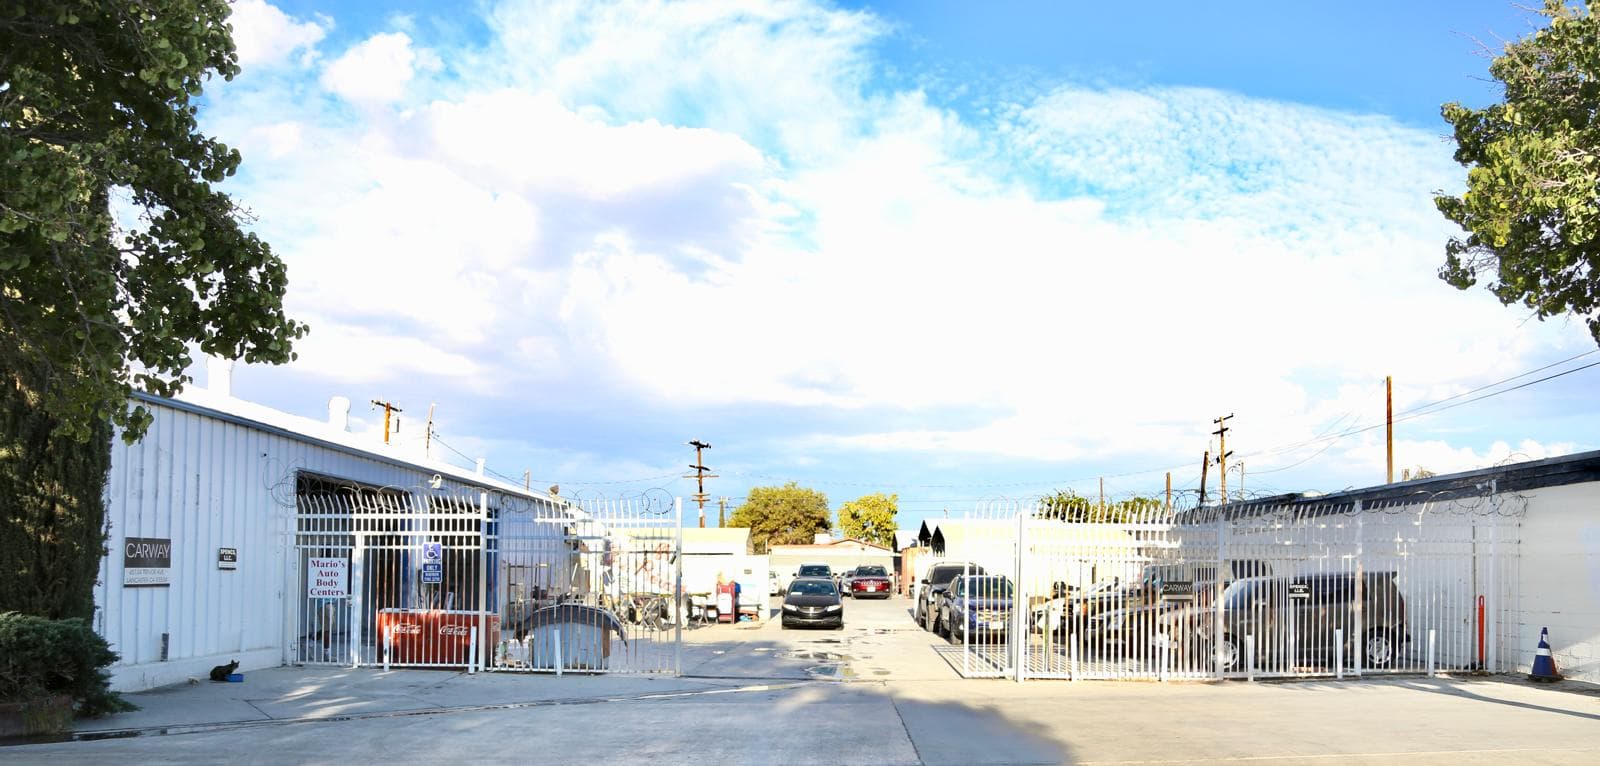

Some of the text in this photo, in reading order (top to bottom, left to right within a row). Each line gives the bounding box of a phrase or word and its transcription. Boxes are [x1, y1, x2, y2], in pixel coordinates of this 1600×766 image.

[126, 543, 170, 558] CARWAY
[311, 560, 345, 568] Mario's
[316, 579, 339, 587] Body
[1163, 584, 1192, 592] CARWAY
